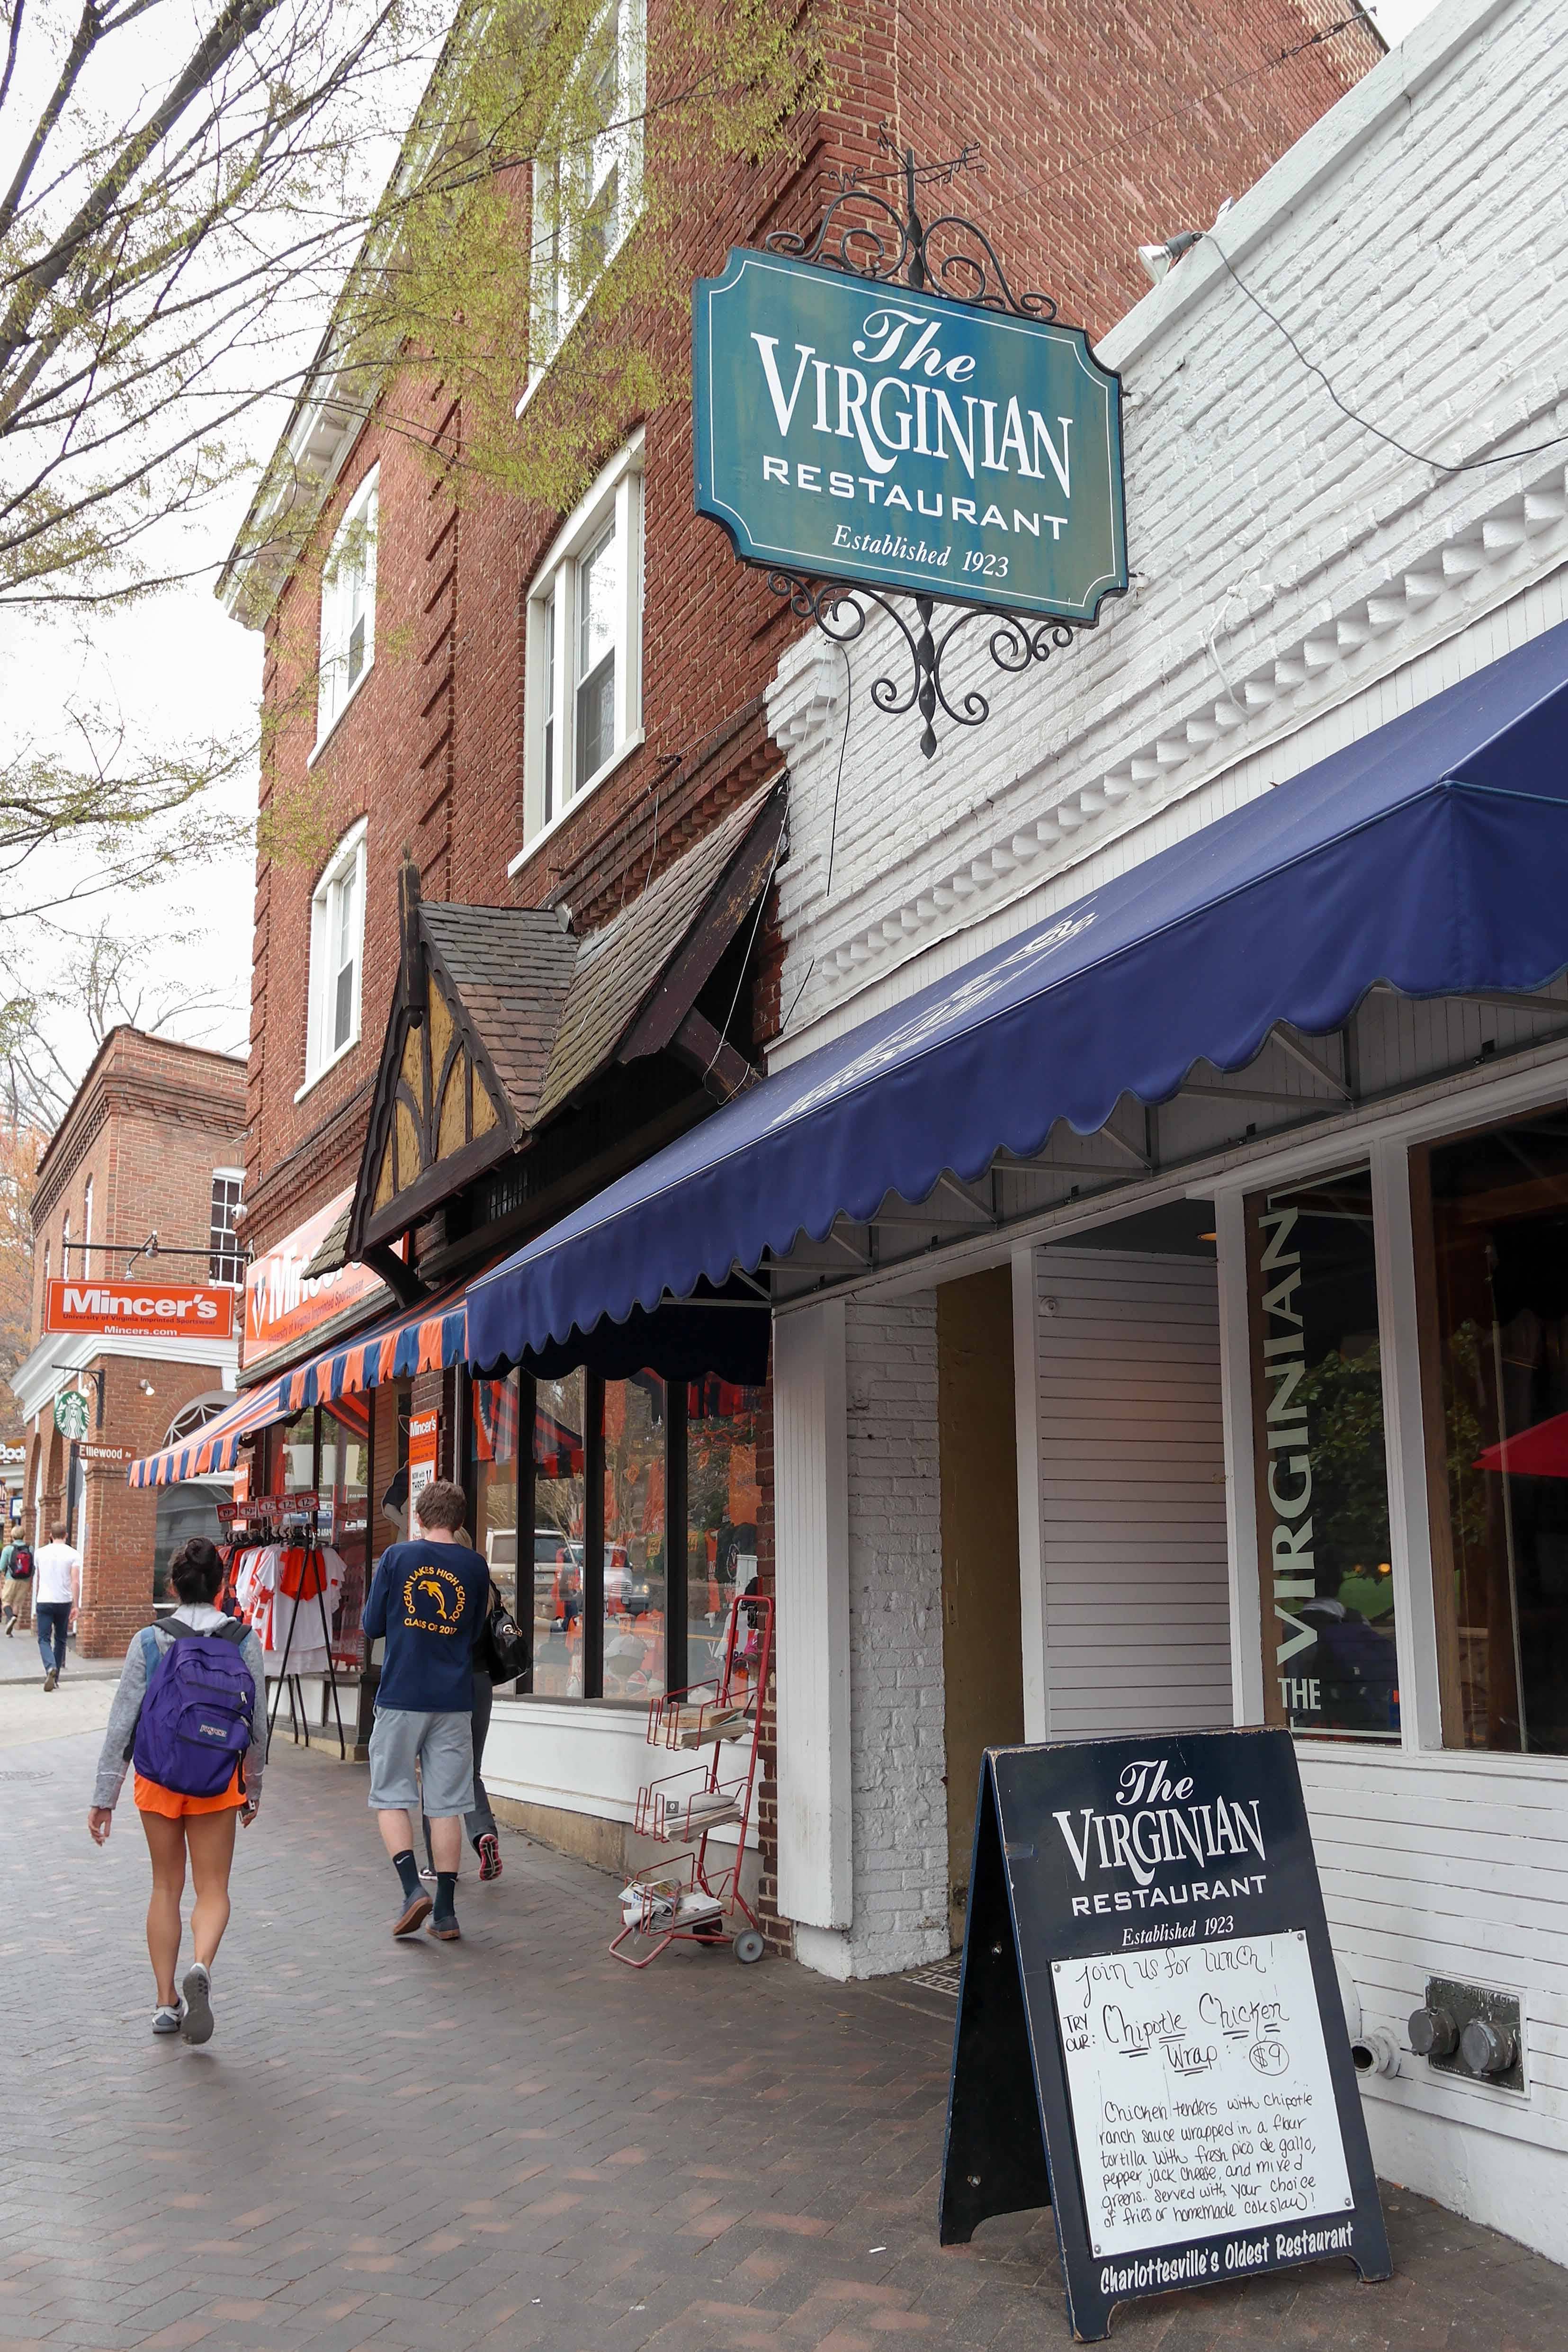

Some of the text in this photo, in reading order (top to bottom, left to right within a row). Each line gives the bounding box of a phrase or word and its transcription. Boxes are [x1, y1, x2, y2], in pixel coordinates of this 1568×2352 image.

[852, 308, 976, 382] The
[751, 332, 1073, 499] VIRGINIAN
[763, 455, 1068, 540] RESTAURANT
[832, 525, 1009, 577] Established 1923
[63, 1288, 217, 1319] Mincer's
[312, 1298, 334, 1321] Imprinted
[335, 1280, 364, 1310] Sportswear
[63, 1313, 99, 1321] University
[111, 1315, 138, 1323] Virginia
[140, 1317, 174, 1325] Imprinted
[176, 1318, 215, 1326] Sportswear
[104, 1326, 177, 1337] Mincers.com
[410, 1416, 436, 1437] Mincer's
[1257, 1206, 1318, 1667] VIRGINIAN
[79, 1445, 122, 1459] Elliewood
[403, 1566, 466, 1622] OCEAN LAKES HIGH SCHOOL
[404, 1618, 458, 1635] CLASS OF 2017
[1277, 1677, 1322, 1710] THE
[1116, 1760, 1194, 1806] The
[1052, 1795, 1266, 1885] VIRGINIAN
[1071, 1875, 1267, 1916] RESTAURANT
[1121, 1915, 1234, 1946] Established 1923
[1164, 1947, 1192, 1978] for
[1063, 2013, 1088, 2033] TRY
[1103, 1992, 1290, 2049] Chipotle Chicken
[1066, 2033, 1096, 2052] OUR:
[1253, 2044, 1281, 2069] $9
[1105, 2101, 1167, 2123] Chicken
[1173, 2098, 1218, 2117] tenders
[1228, 2094, 1259, 2110] with
[1099, 2114, 1307, 2146] ranch sauce wrapped in a flour
[1101, 2136, 1316, 2168] tortilla with fresh pico de gallo,
[1103, 2171, 1142, 2191] pepper
[1147, 2169, 1177, 2189] jack
[1226, 2162, 1251, 2177] and
[1256, 2154, 1302, 2173] mixed
[1200, 2183, 1227, 2198] with
[1231, 2183, 1262, 2199] your
[1104, 2210, 1116, 2227] of
[1123, 2208, 1152, 2225] fries
[1156, 2208, 1167, 2221] or
[1173, 2202, 1236, 2221] homemade
[1100, 2221, 1353, 2294] Charlottesville's Oldest Restaurant
